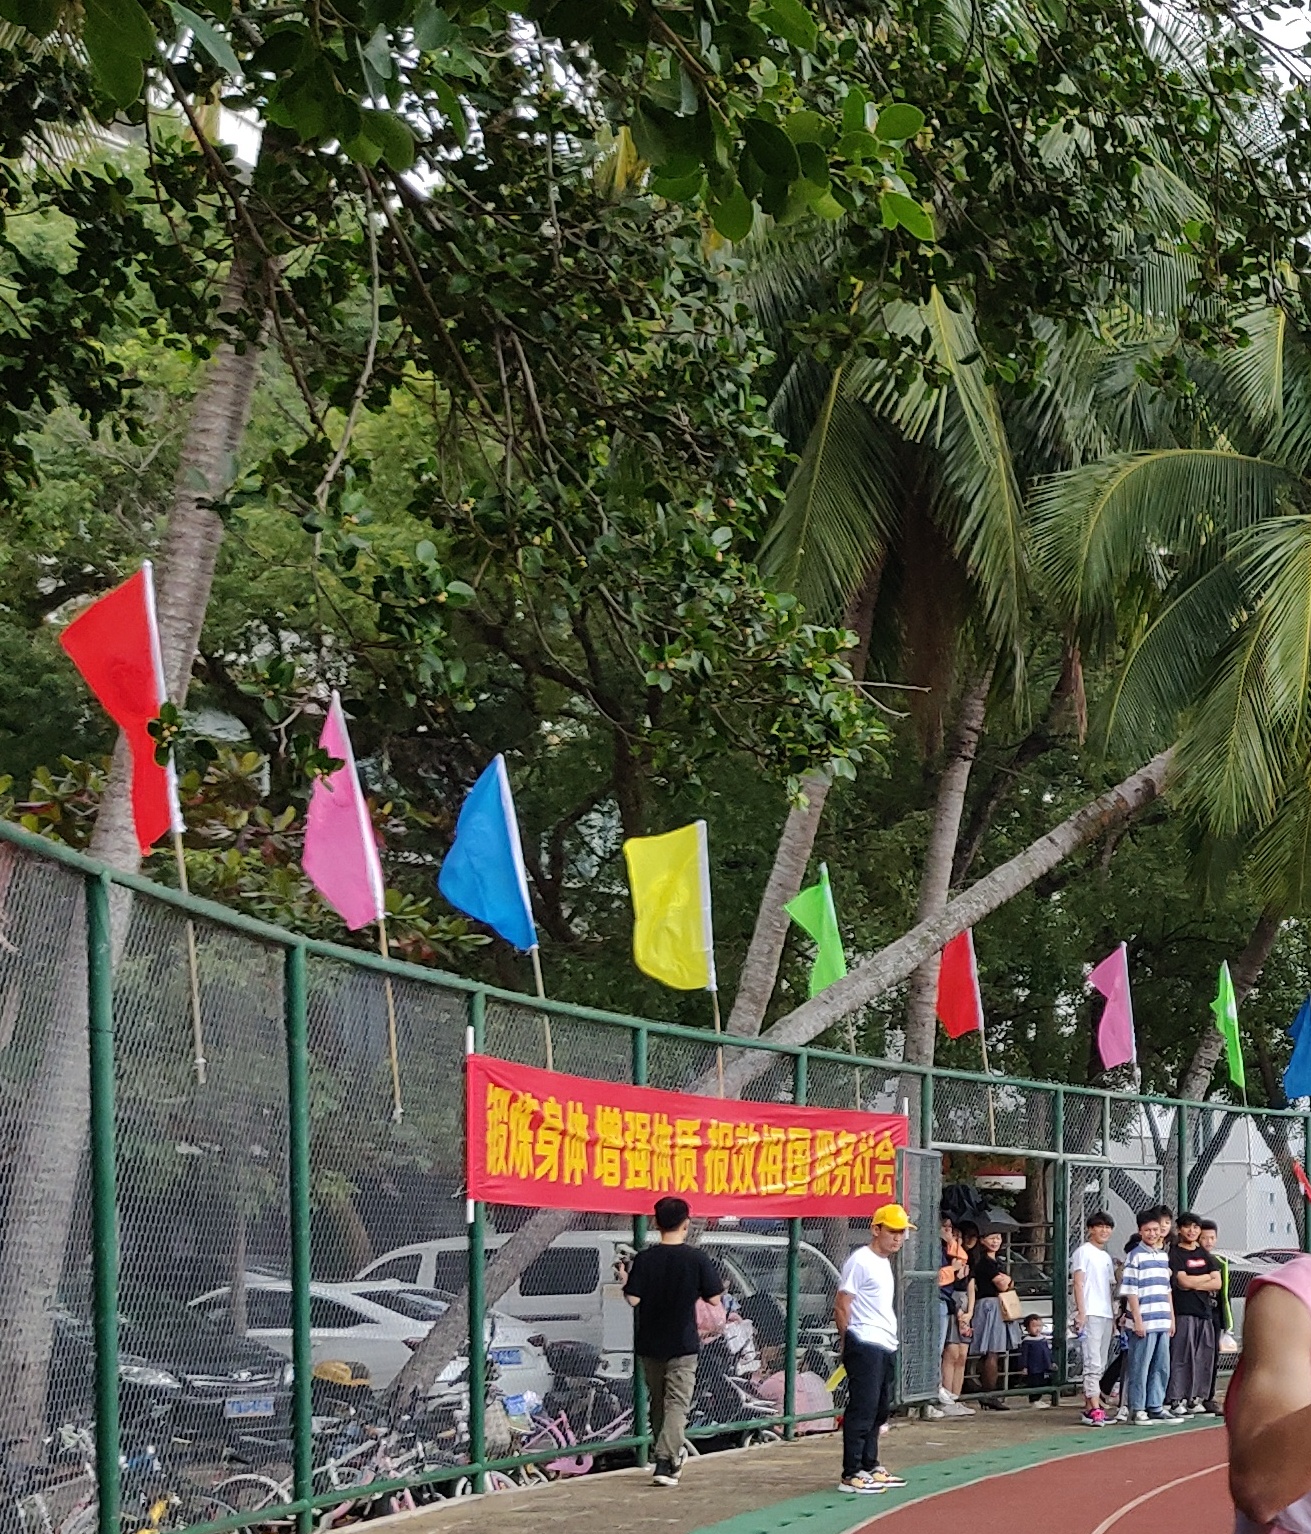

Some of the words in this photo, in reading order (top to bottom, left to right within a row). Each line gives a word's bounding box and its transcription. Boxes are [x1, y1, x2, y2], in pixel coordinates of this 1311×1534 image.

[486, 1083, 590, 1186] 锻炼身体
[594, 1105, 702, 1193] 增强体质
[704, 1118, 811, 1196] 报效祖国
[812, 1129, 895, 1197] 服务社会
